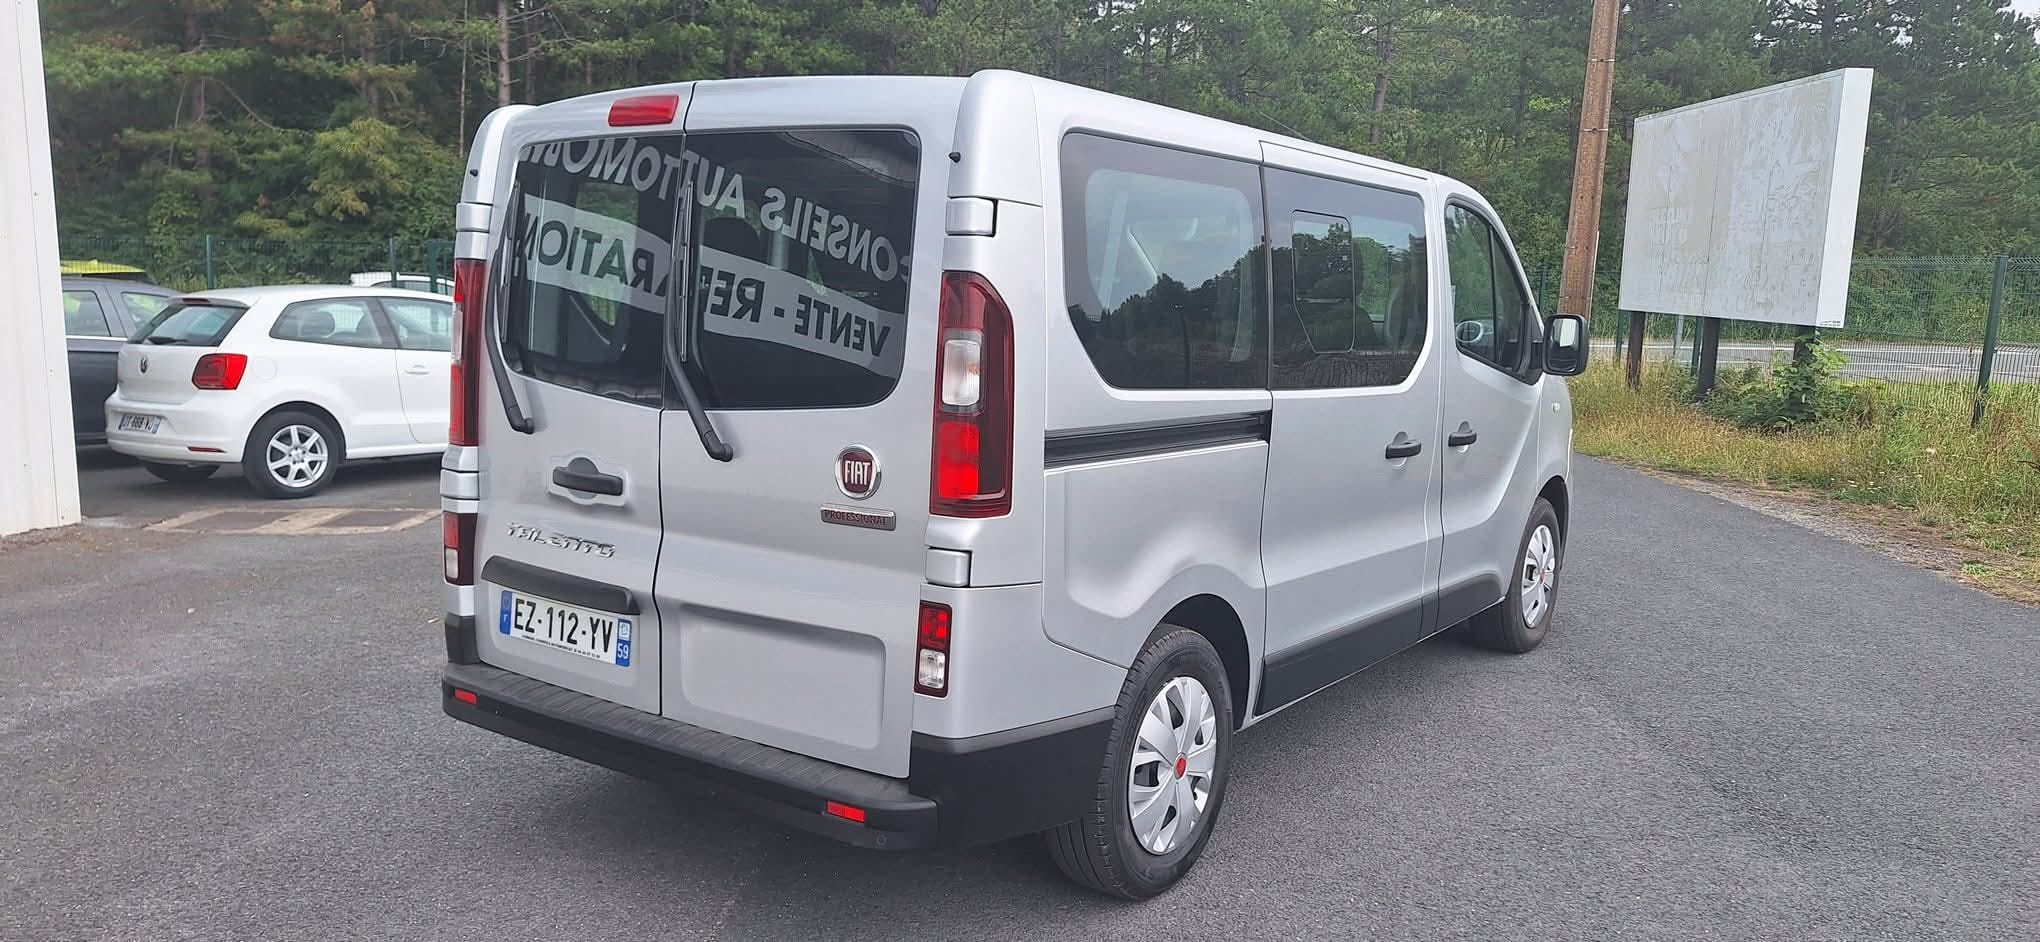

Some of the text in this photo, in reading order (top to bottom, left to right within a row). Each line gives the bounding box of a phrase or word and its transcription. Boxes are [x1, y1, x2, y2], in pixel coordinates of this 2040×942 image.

[844, 460, 871, 485] FIAT
[823, 509, 887, 525] PROFESSIONAL
[514, 598, 613, 653] EZ-112-YV
[617, 642, 629, 660] 59
